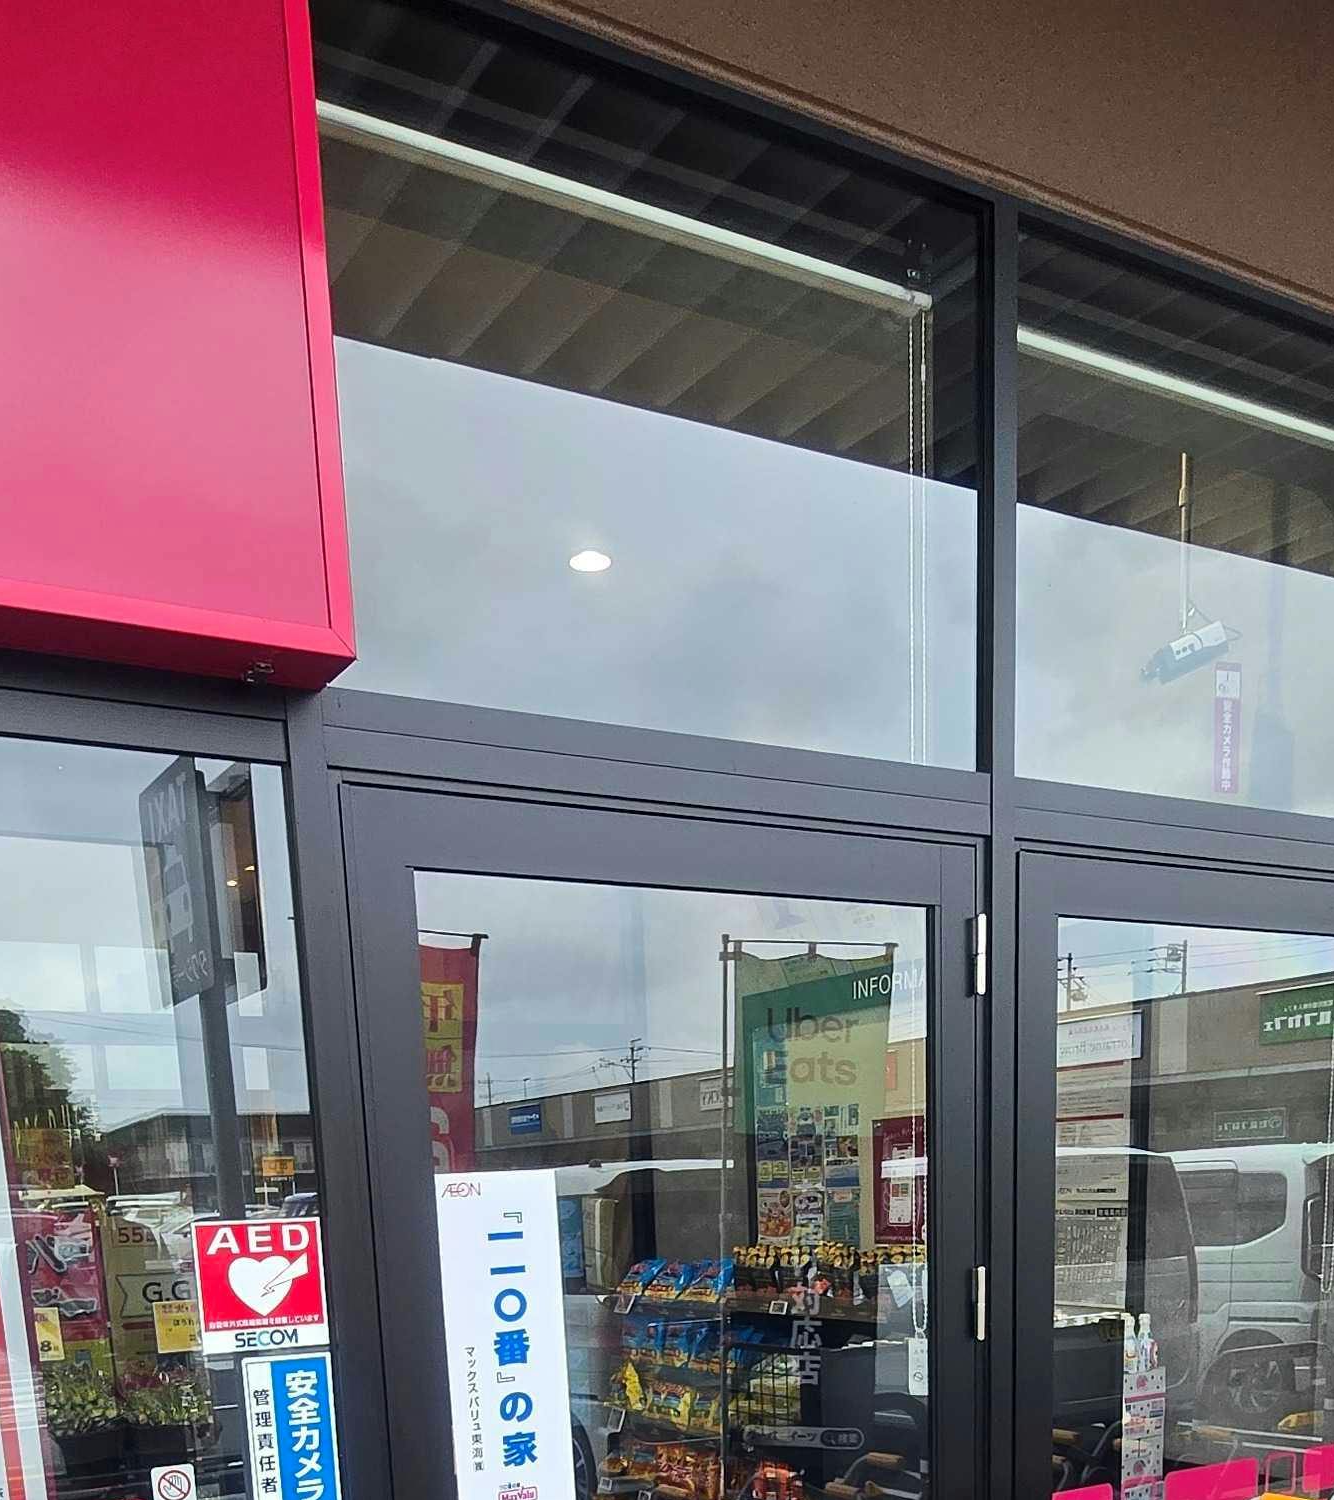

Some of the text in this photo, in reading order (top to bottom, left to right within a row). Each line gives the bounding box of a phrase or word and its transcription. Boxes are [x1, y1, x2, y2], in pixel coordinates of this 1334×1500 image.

[770, 1052, 857, 1086] ats
[206, 1223, 310, 1256] AED
[235, 1328, 299, 1348] SECOM
[252, 1389, 278, 1494] 管理責任者
